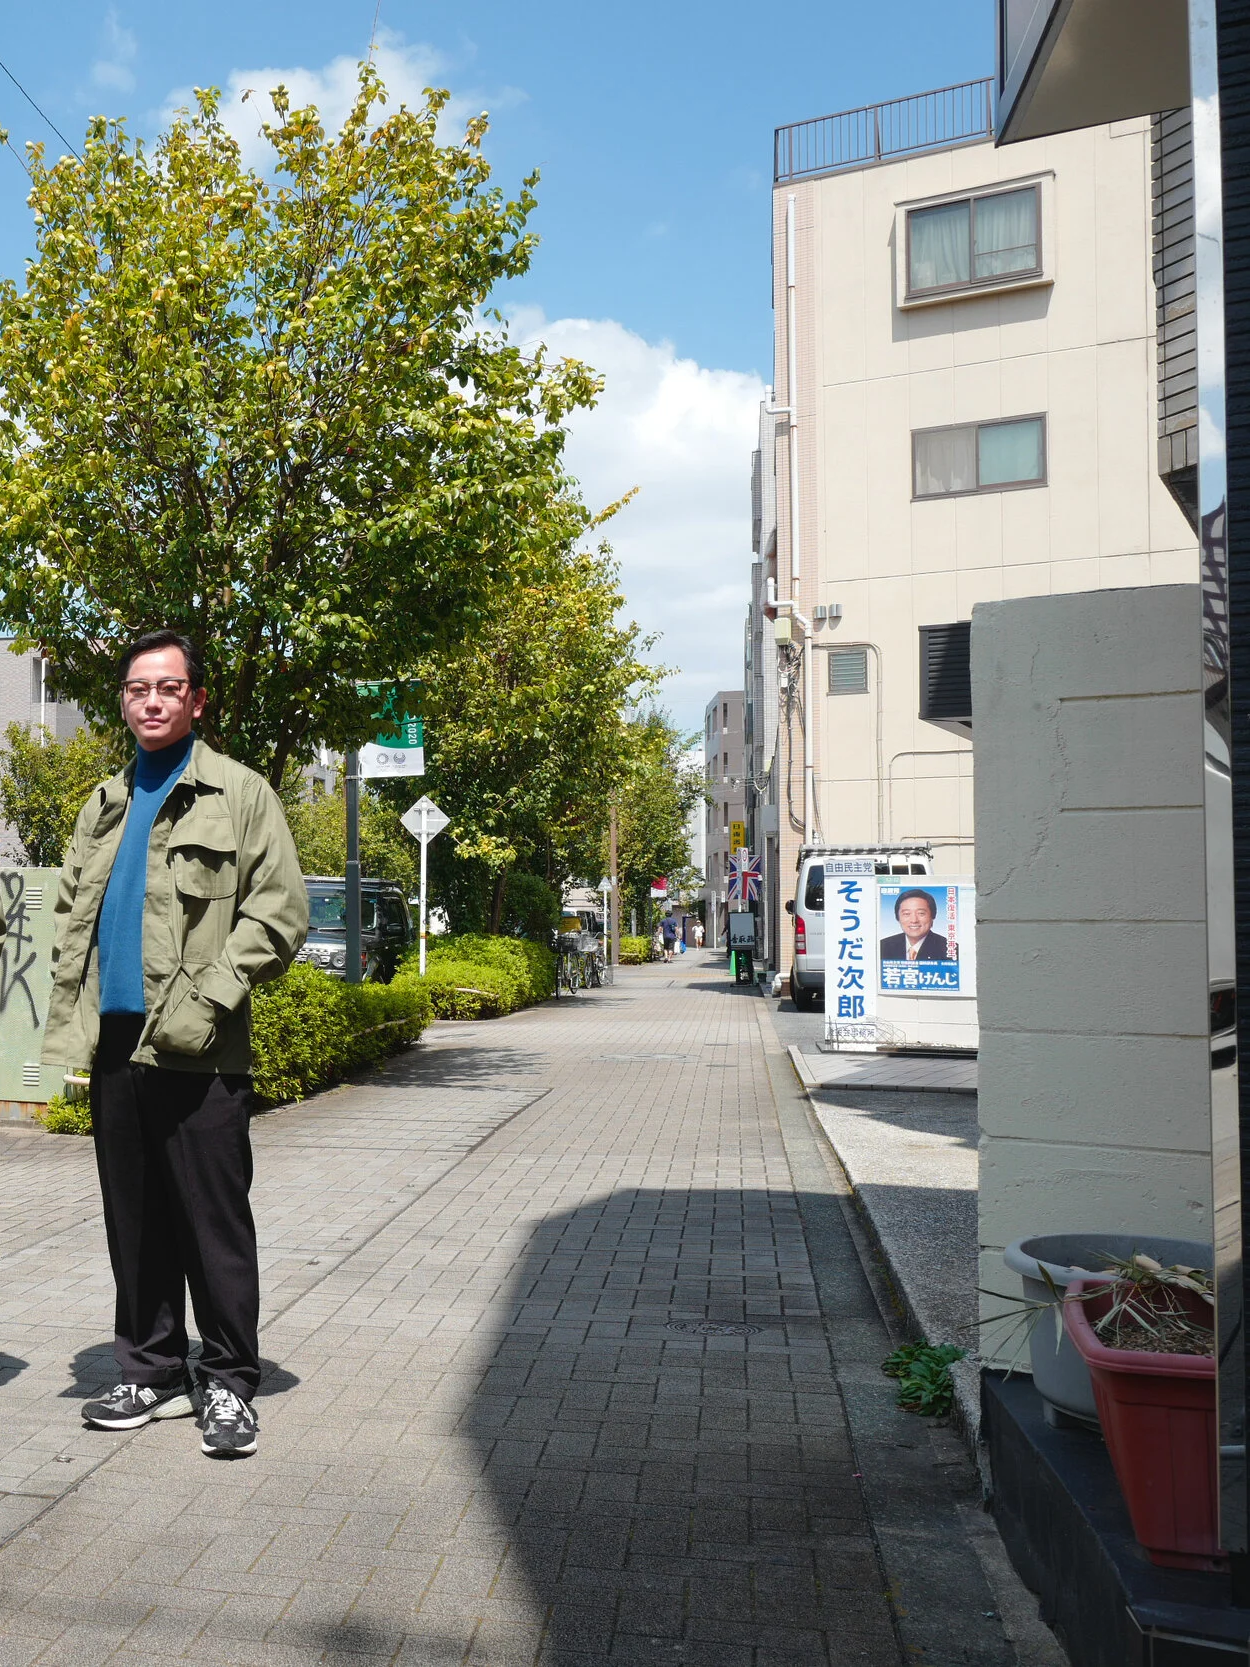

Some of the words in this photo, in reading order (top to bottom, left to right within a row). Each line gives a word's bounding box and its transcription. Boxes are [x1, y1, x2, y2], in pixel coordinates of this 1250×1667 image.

[826, 862, 872, 872] 自由民主党
[947, 888, 956, 919] 日本復活
[837, 880, 865, 1019] そうだ次郎
[883, 968, 957, 985] 若宮けんじ
[137, 1387, 158, 1405] N
